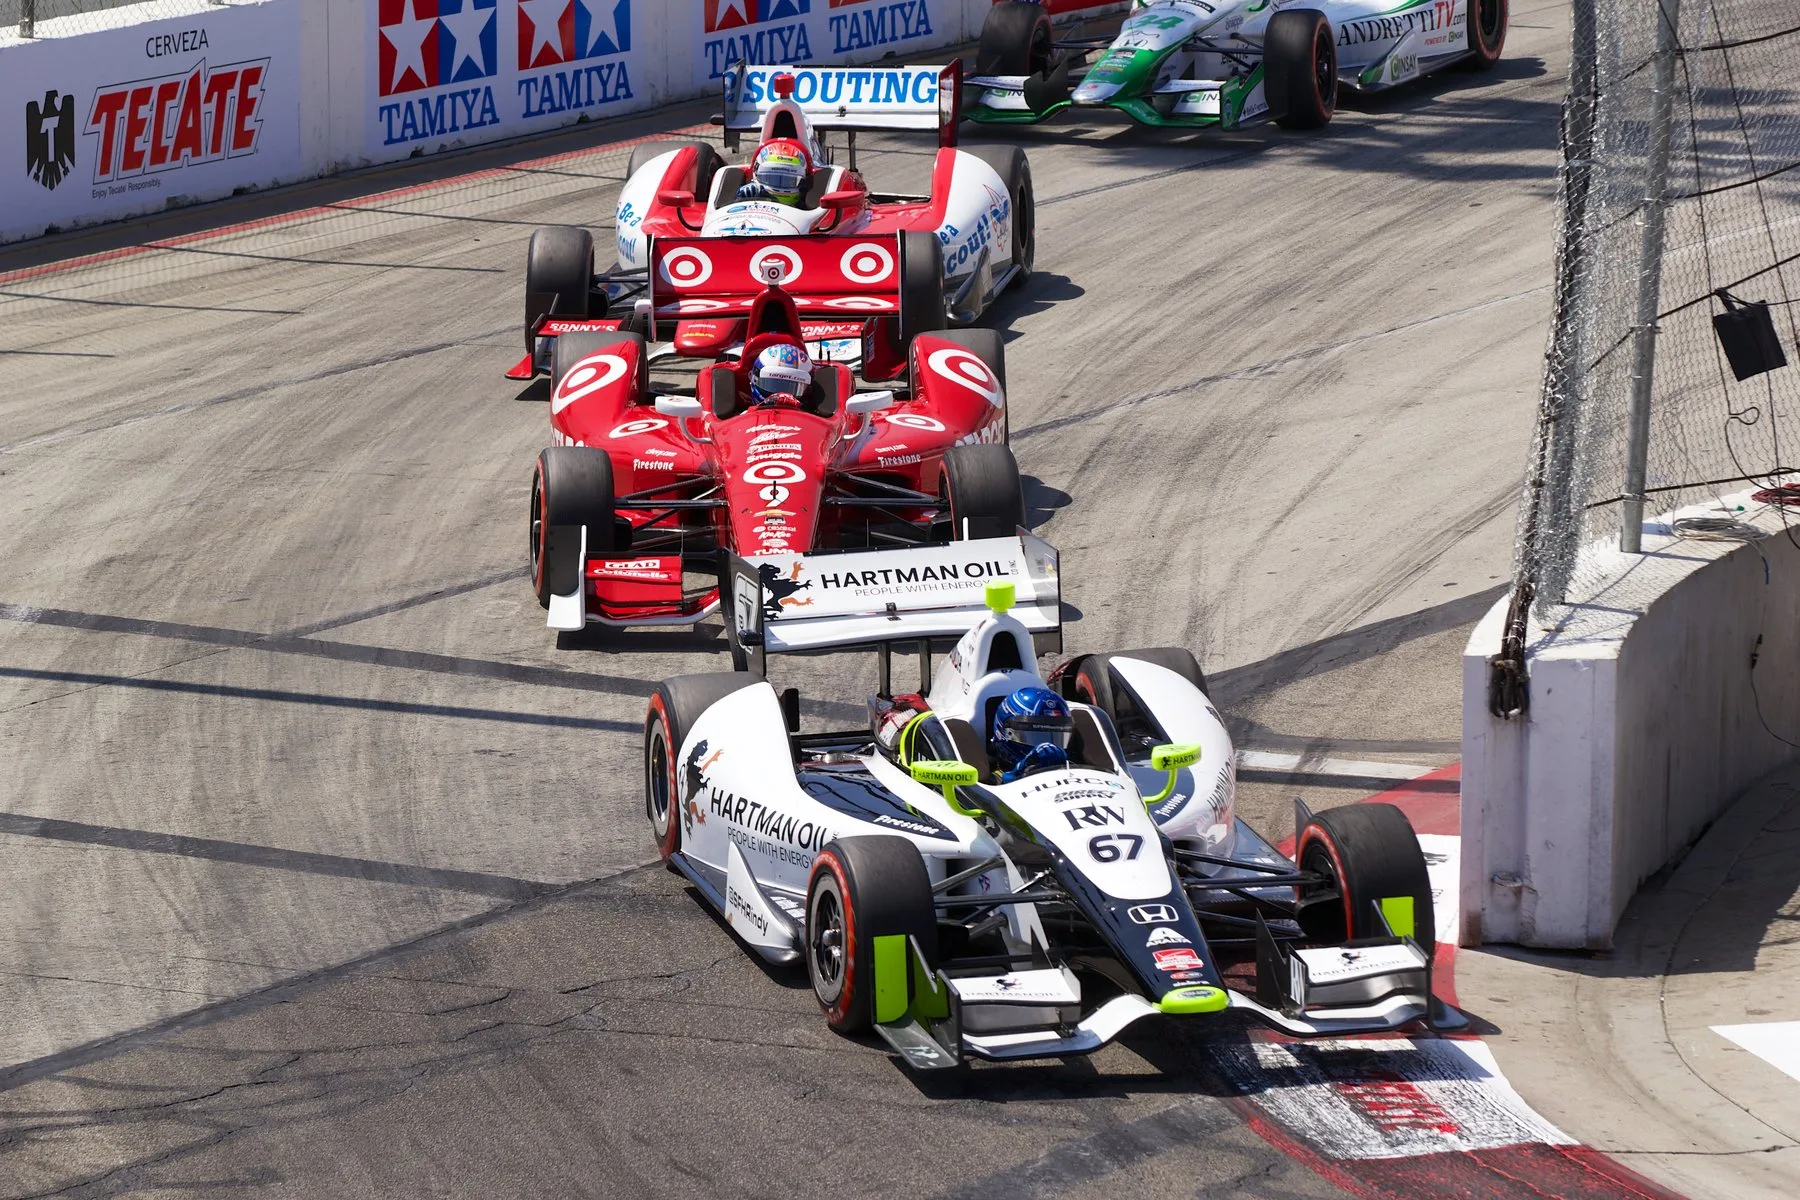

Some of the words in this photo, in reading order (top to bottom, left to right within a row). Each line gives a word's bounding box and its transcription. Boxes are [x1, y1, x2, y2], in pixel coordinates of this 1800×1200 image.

[829, 0, 933, 54] TAMIYA
[146, 29, 209, 58] CERVEZA
[704, 22, 814, 80] TAMIYA
[518, 61, 633, 118] TAMIYA
[91, 66, 263, 176] TECATE
[379, 85, 500, 146] TAMIYA
[92, 189, 107, 200] Enjoy
[619, 202, 634, 223] Be
[944, 213, 991, 274] cout!
[800, 324, 860, 334] ONNY'S
[633, 459, 674, 471] Firestone
[878, 454, 921, 468] Firestone
[759, 485, 790, 507] 9
[821, 564, 959, 589] HARTMAN
[964, 560, 1010, 578] OIL
[855, 586, 902, 597] PEOPLE
[906, 583, 938, 594] WITH
[942, 579, 990, 592] ENERGY
[918, 771, 954, 781] HARTMAN
[955, 773, 970, 782] OIL
[1021, 777, 1125, 799] HURCO
[710, 787, 800, 844] HARTMAN
[1154, 793, 1187, 817] Firestone
[873, 814, 940, 835] Firestone
[727, 826, 756, 852] PEOPLE
[758, 836, 779, 859] WITH
[780, 847, 815, 869] ENERGY
[1087, 833, 1146, 864] 67
